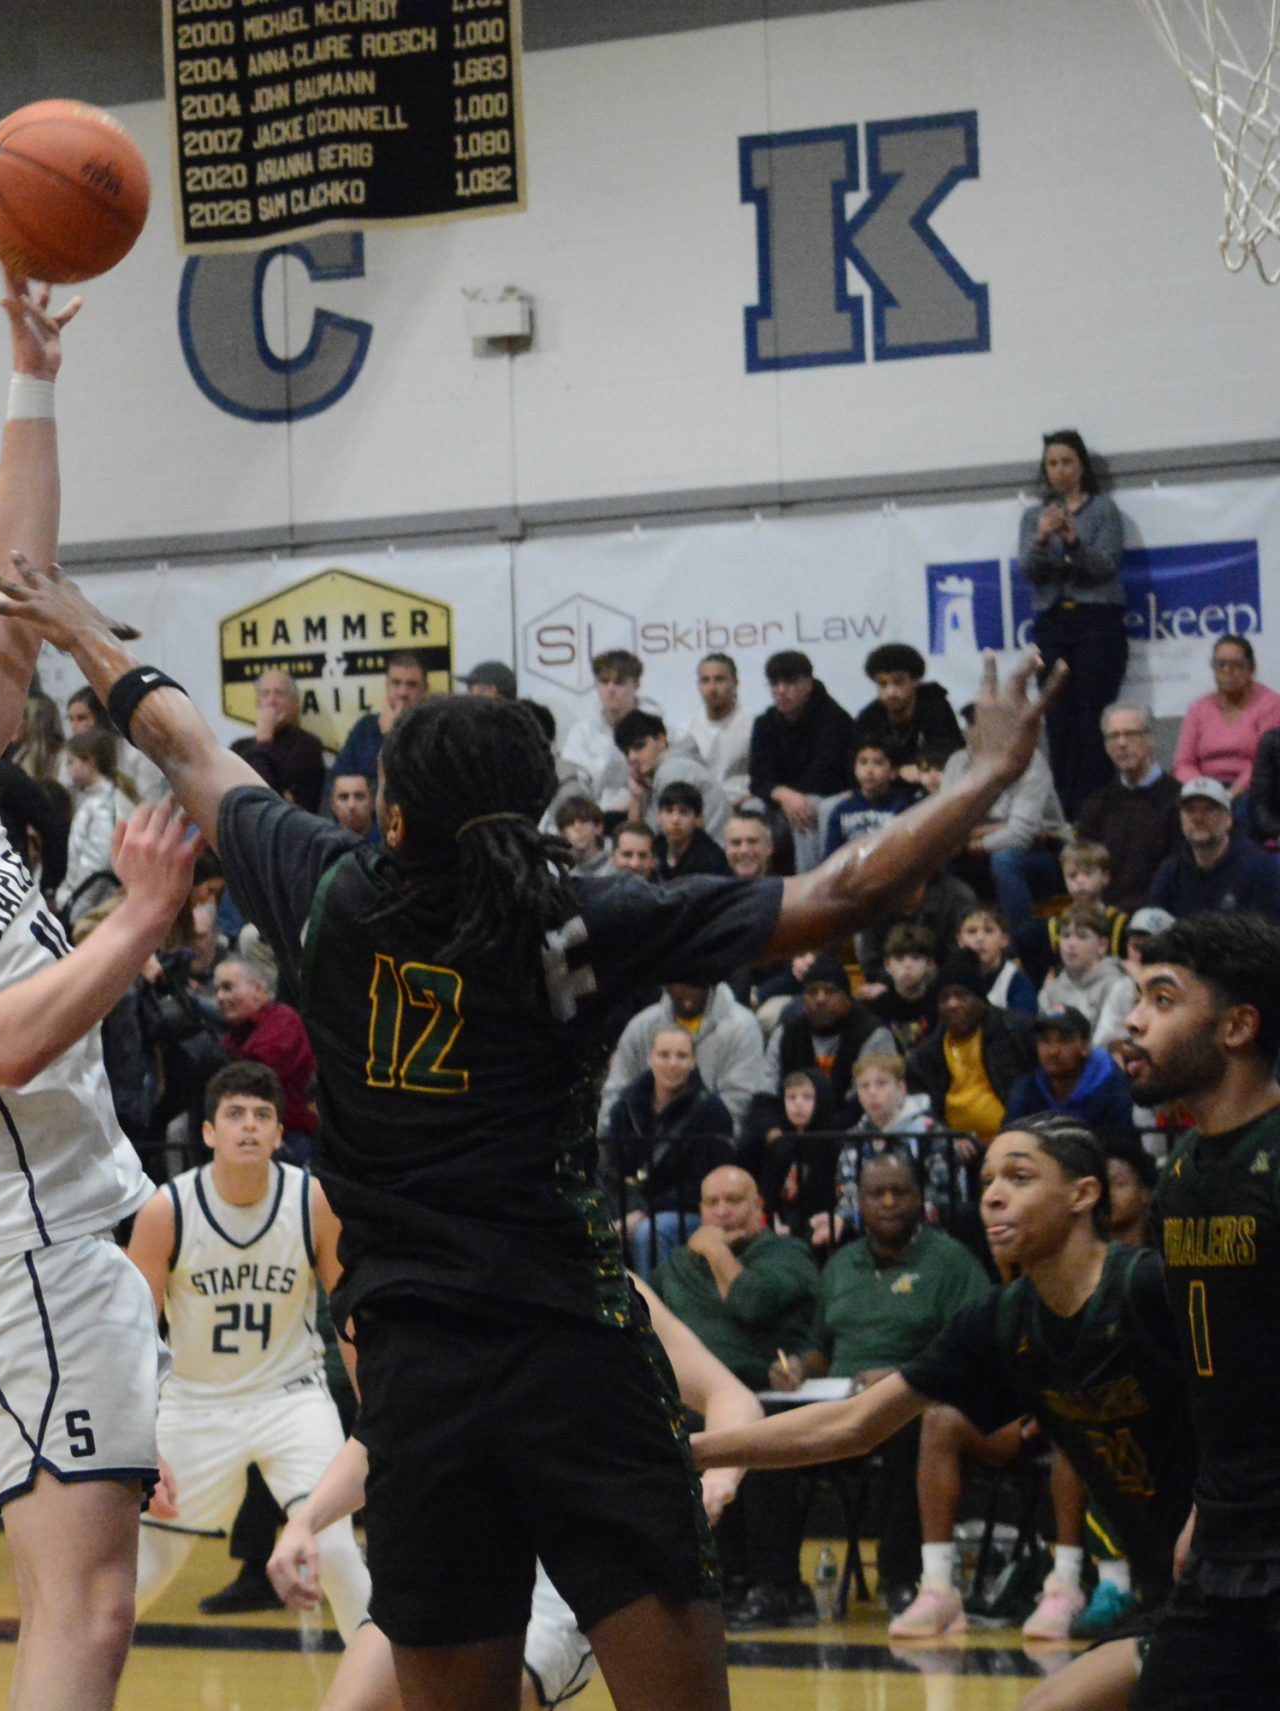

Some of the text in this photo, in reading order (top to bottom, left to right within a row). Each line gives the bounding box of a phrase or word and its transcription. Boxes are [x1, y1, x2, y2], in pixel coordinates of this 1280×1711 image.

[177, 21, 235, 49] 2000
[243, 7, 310, 41] MICHAEL
[179, 57, 238, 86] 2004
[361, 27, 437, 58] ROESCH
[453, 18, 505, 49] 1,000
[181, 92, 242, 121] 2004
[250, 83, 290, 114] JOHN
[294, 70, 376, 104] BAUMANN
[183, 128, 244, 157] 2007
[306, 105, 409, 138] O'CONNELL
[454, 92, 509, 123] 1,000
[186, 163, 248, 192] 2020
[256, 151, 315, 186] ARIANNA
[258, 193, 287, 222] SAM
[240, 609, 429, 647] HAMMER
[640, 610, 887, 653] Skiber Law
[1017, 592, 1259, 650] cekeep
[366, 952, 469, 1094] 12
[190, 1263, 298, 1296] STAPLES
[212, 1303, 272, 1354] 24
[1188, 1280, 1214, 1377] 1
[64, 1408, 97, 1458] S
